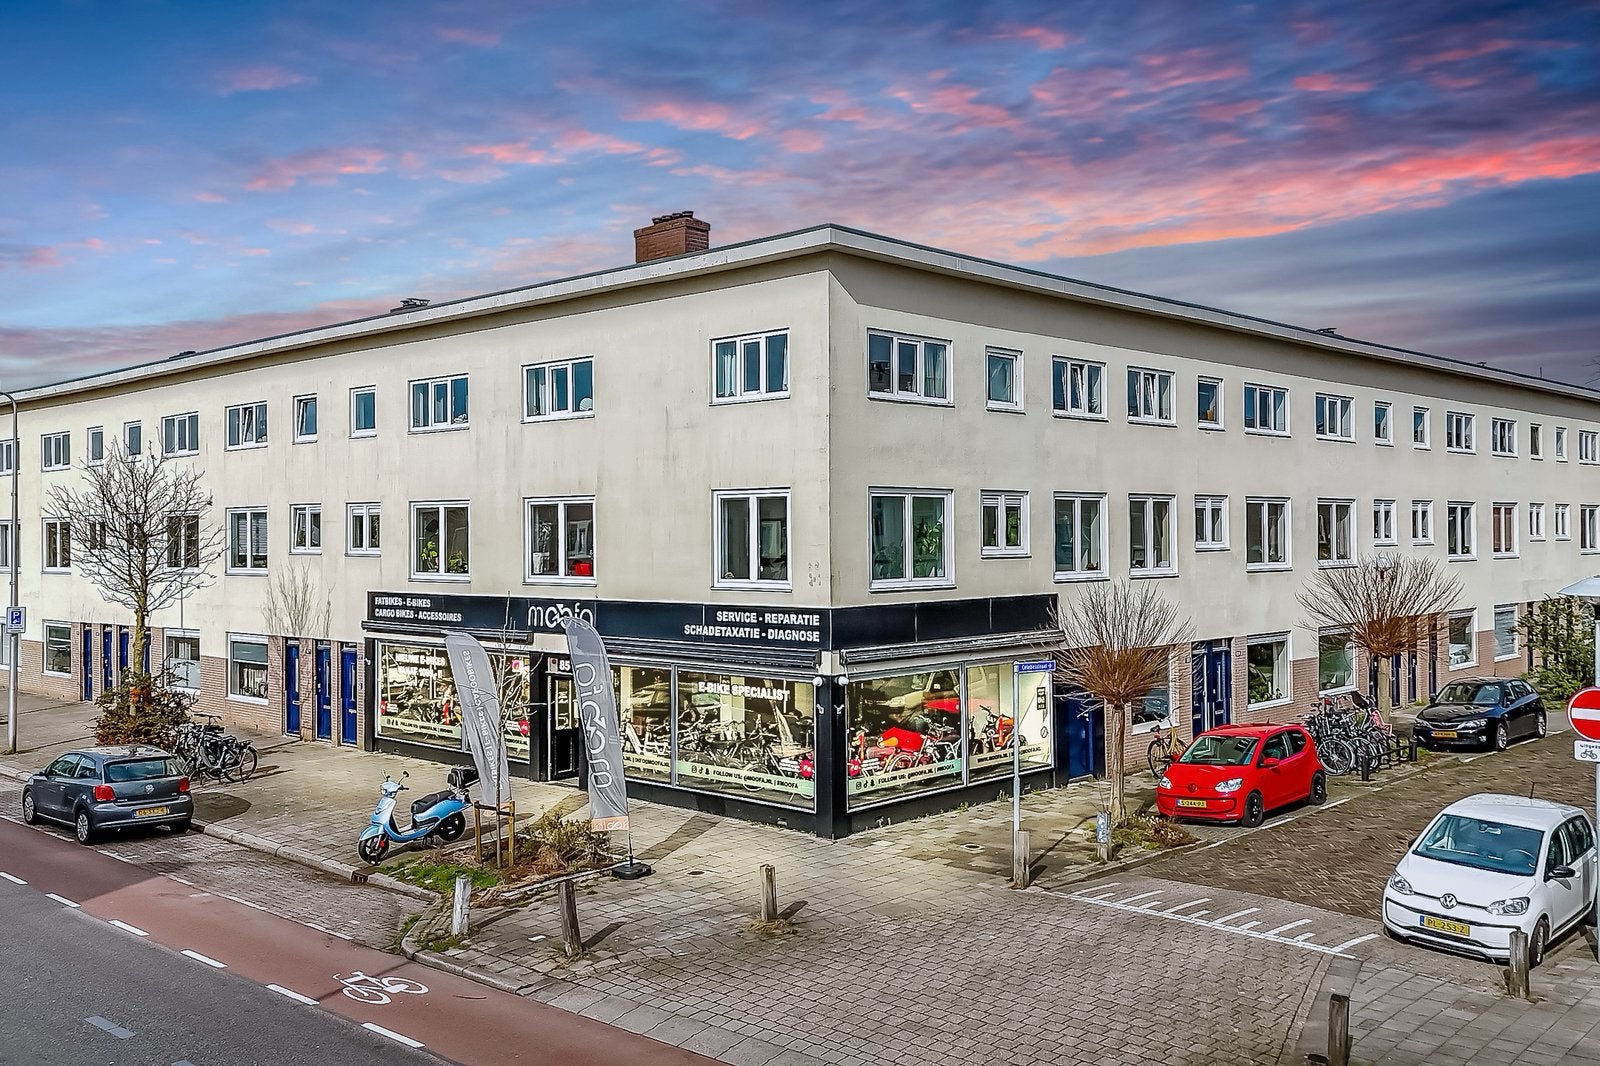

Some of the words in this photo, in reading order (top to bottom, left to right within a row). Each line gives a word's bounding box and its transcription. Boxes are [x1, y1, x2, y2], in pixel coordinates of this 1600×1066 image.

[374, 597, 402, 606] FATBIKES
[406, 598, 431, 608] E-BIKES
[374, 609, 395, 617] CARGO
[396, 609, 414, 618] BIKES
[418, 611, 462, 622] ACCESSOIRES
[716, 611, 757, 623] SERVICE
[764, 613, 820, 626] REPARATIE
[684, 625, 760, 638] SCHADETAXATIE
[767, 629, 820, 642] DIAGNOSE
[559, 660, 571, 671] 85
[698, 682, 730, 694] E-BIKE
[731, 684, 790, 701] SPECIALIST
[713, 770, 733, 779] FOLLOW
[878, 775, 898, 784] FOLLOW
[1427, 918, 1465, 933] PL-253-Z
